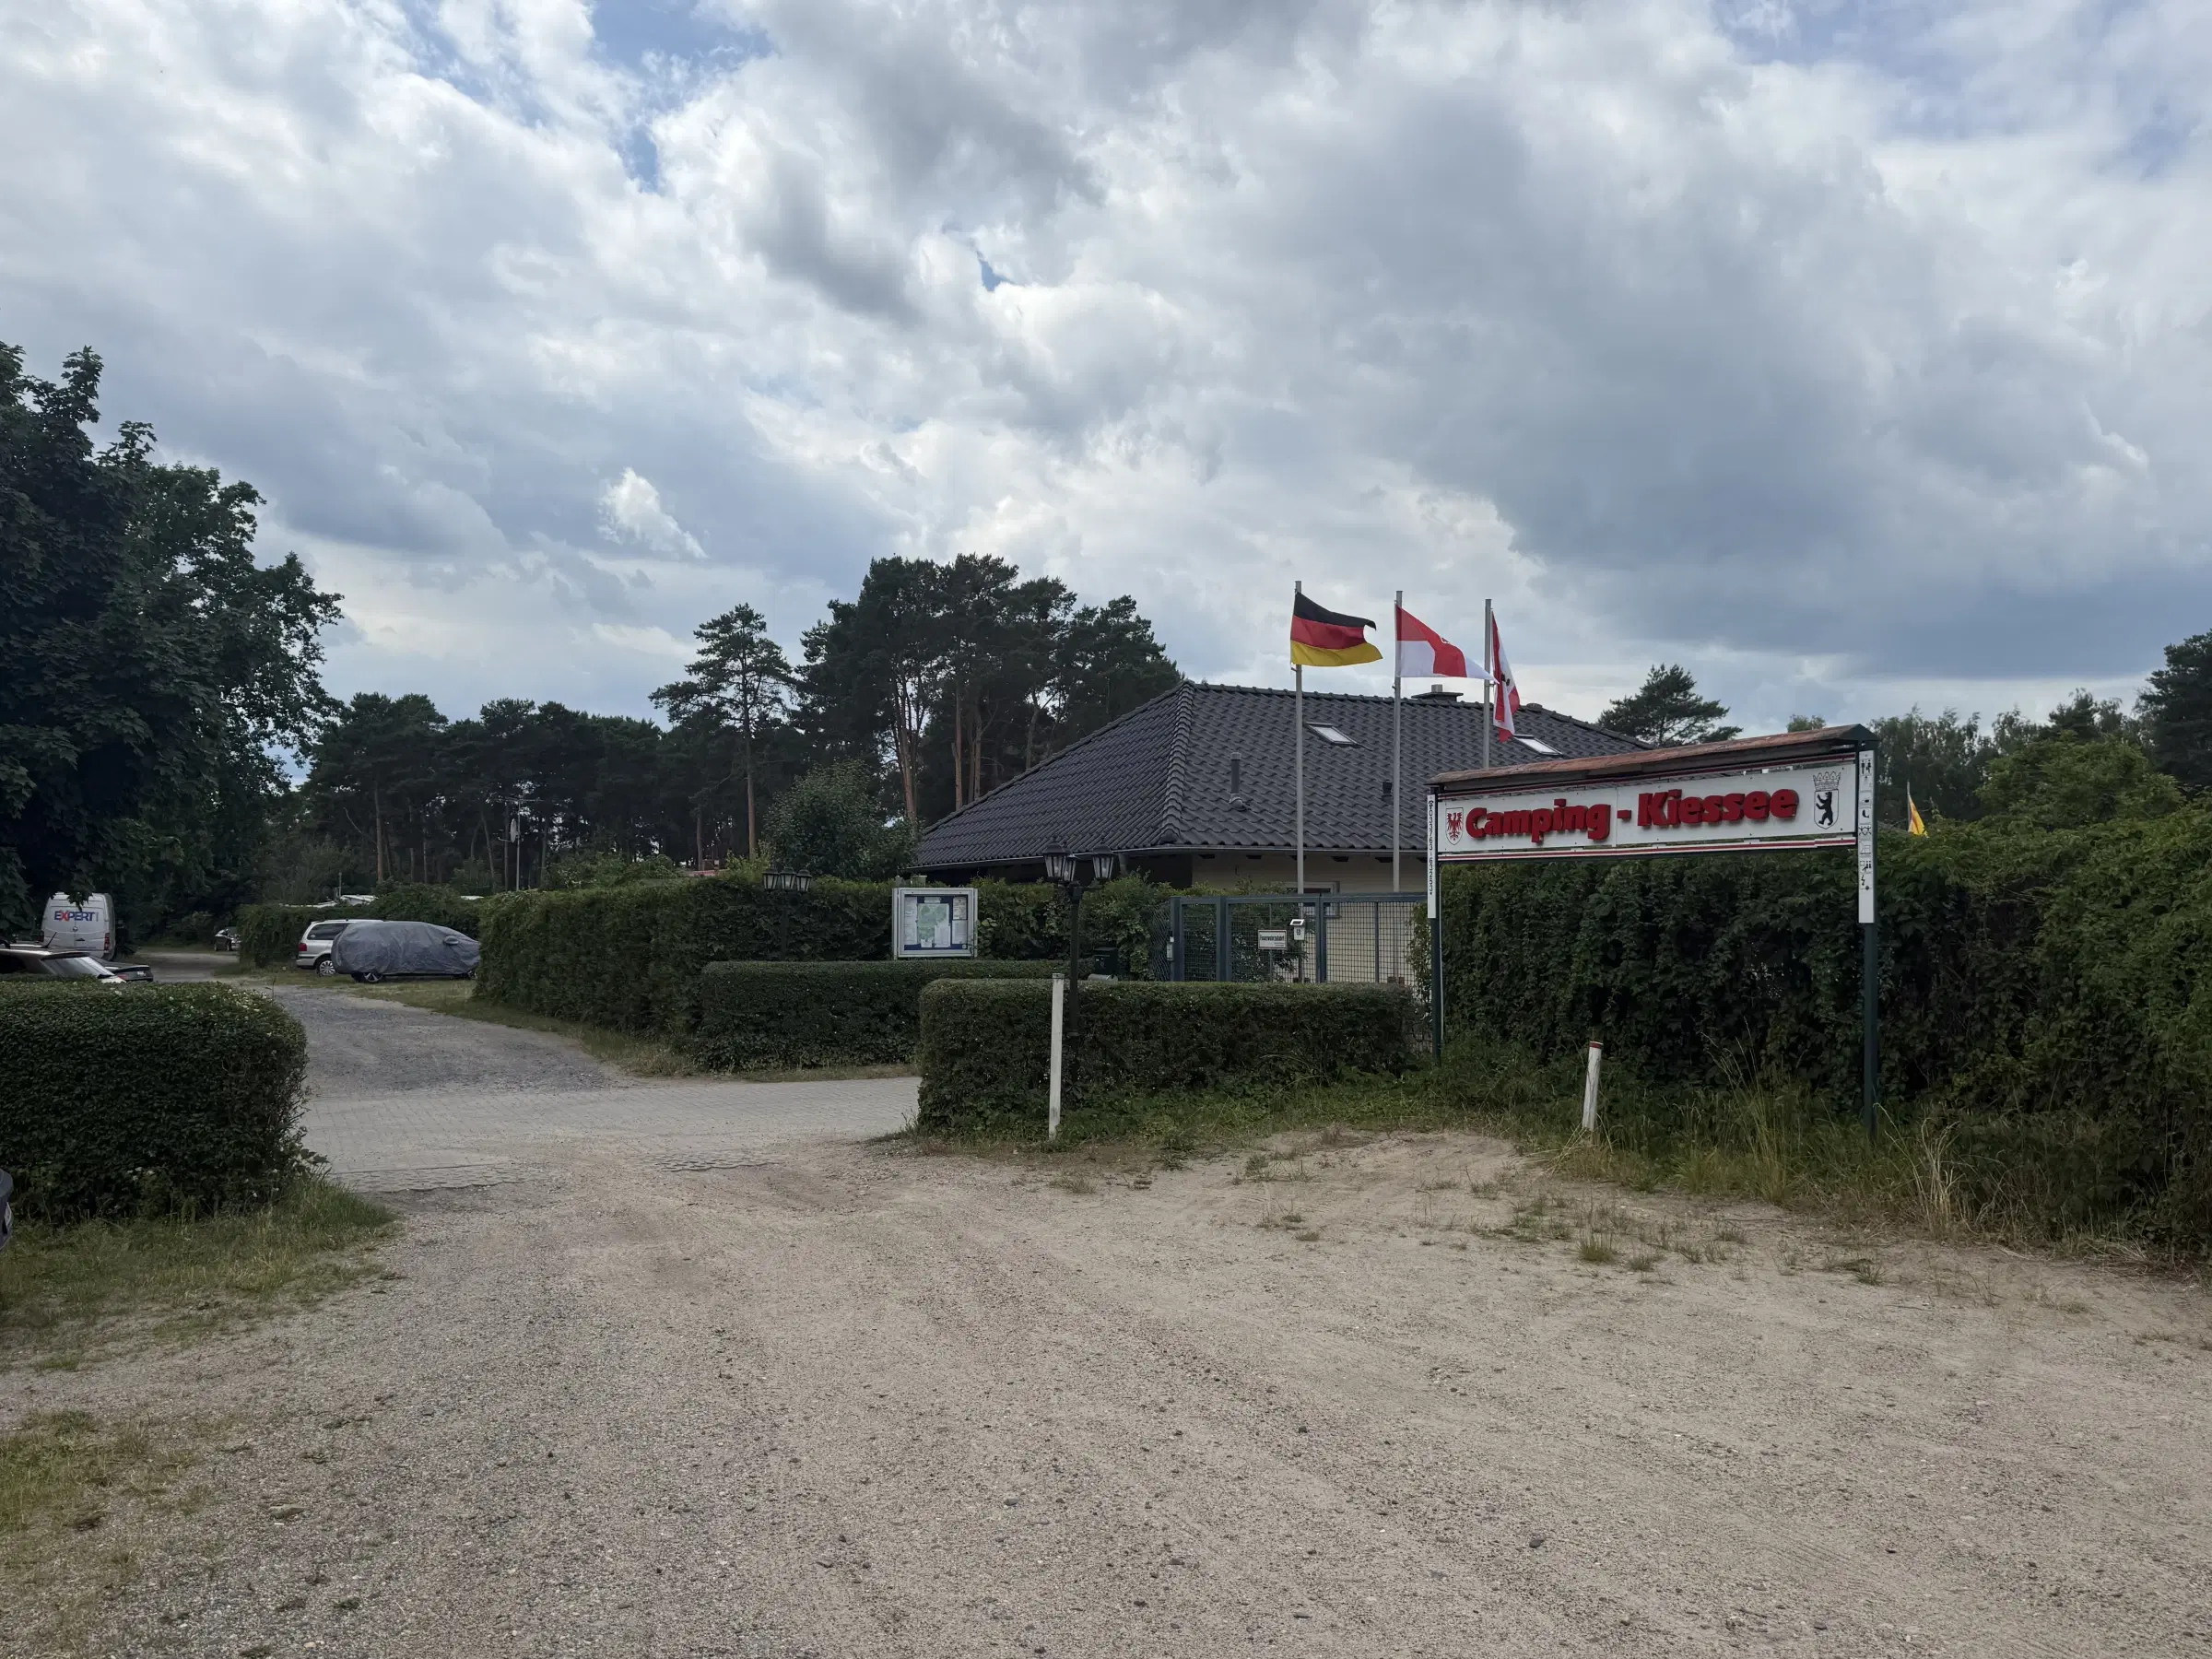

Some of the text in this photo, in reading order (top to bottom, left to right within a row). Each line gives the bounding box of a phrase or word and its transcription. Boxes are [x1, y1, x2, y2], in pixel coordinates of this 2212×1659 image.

[1465, 798, 1611, 843] Camping
[1637, 788, 1799, 827] Kiessee
[53, 910, 95, 922] EXPERT
